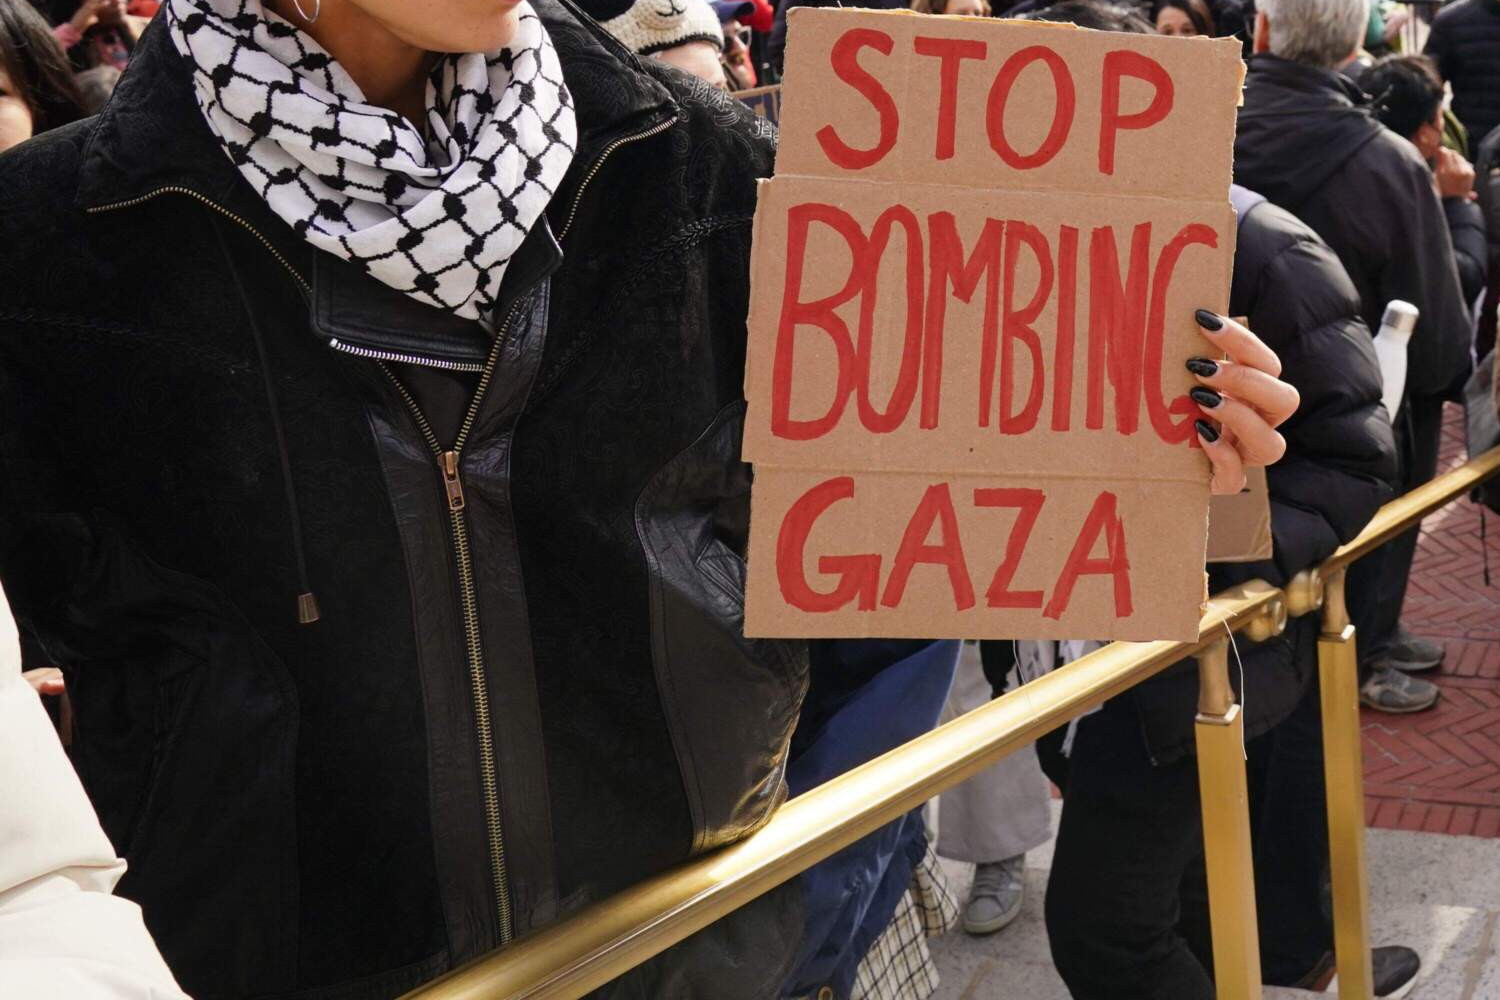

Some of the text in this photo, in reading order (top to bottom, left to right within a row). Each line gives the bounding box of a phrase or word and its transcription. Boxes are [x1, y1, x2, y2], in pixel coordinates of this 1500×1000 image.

[815, 27, 1175, 175] STOP
[770, 202, 1218, 449] BOMBING
[775, 476, 1133, 620] GAZA
